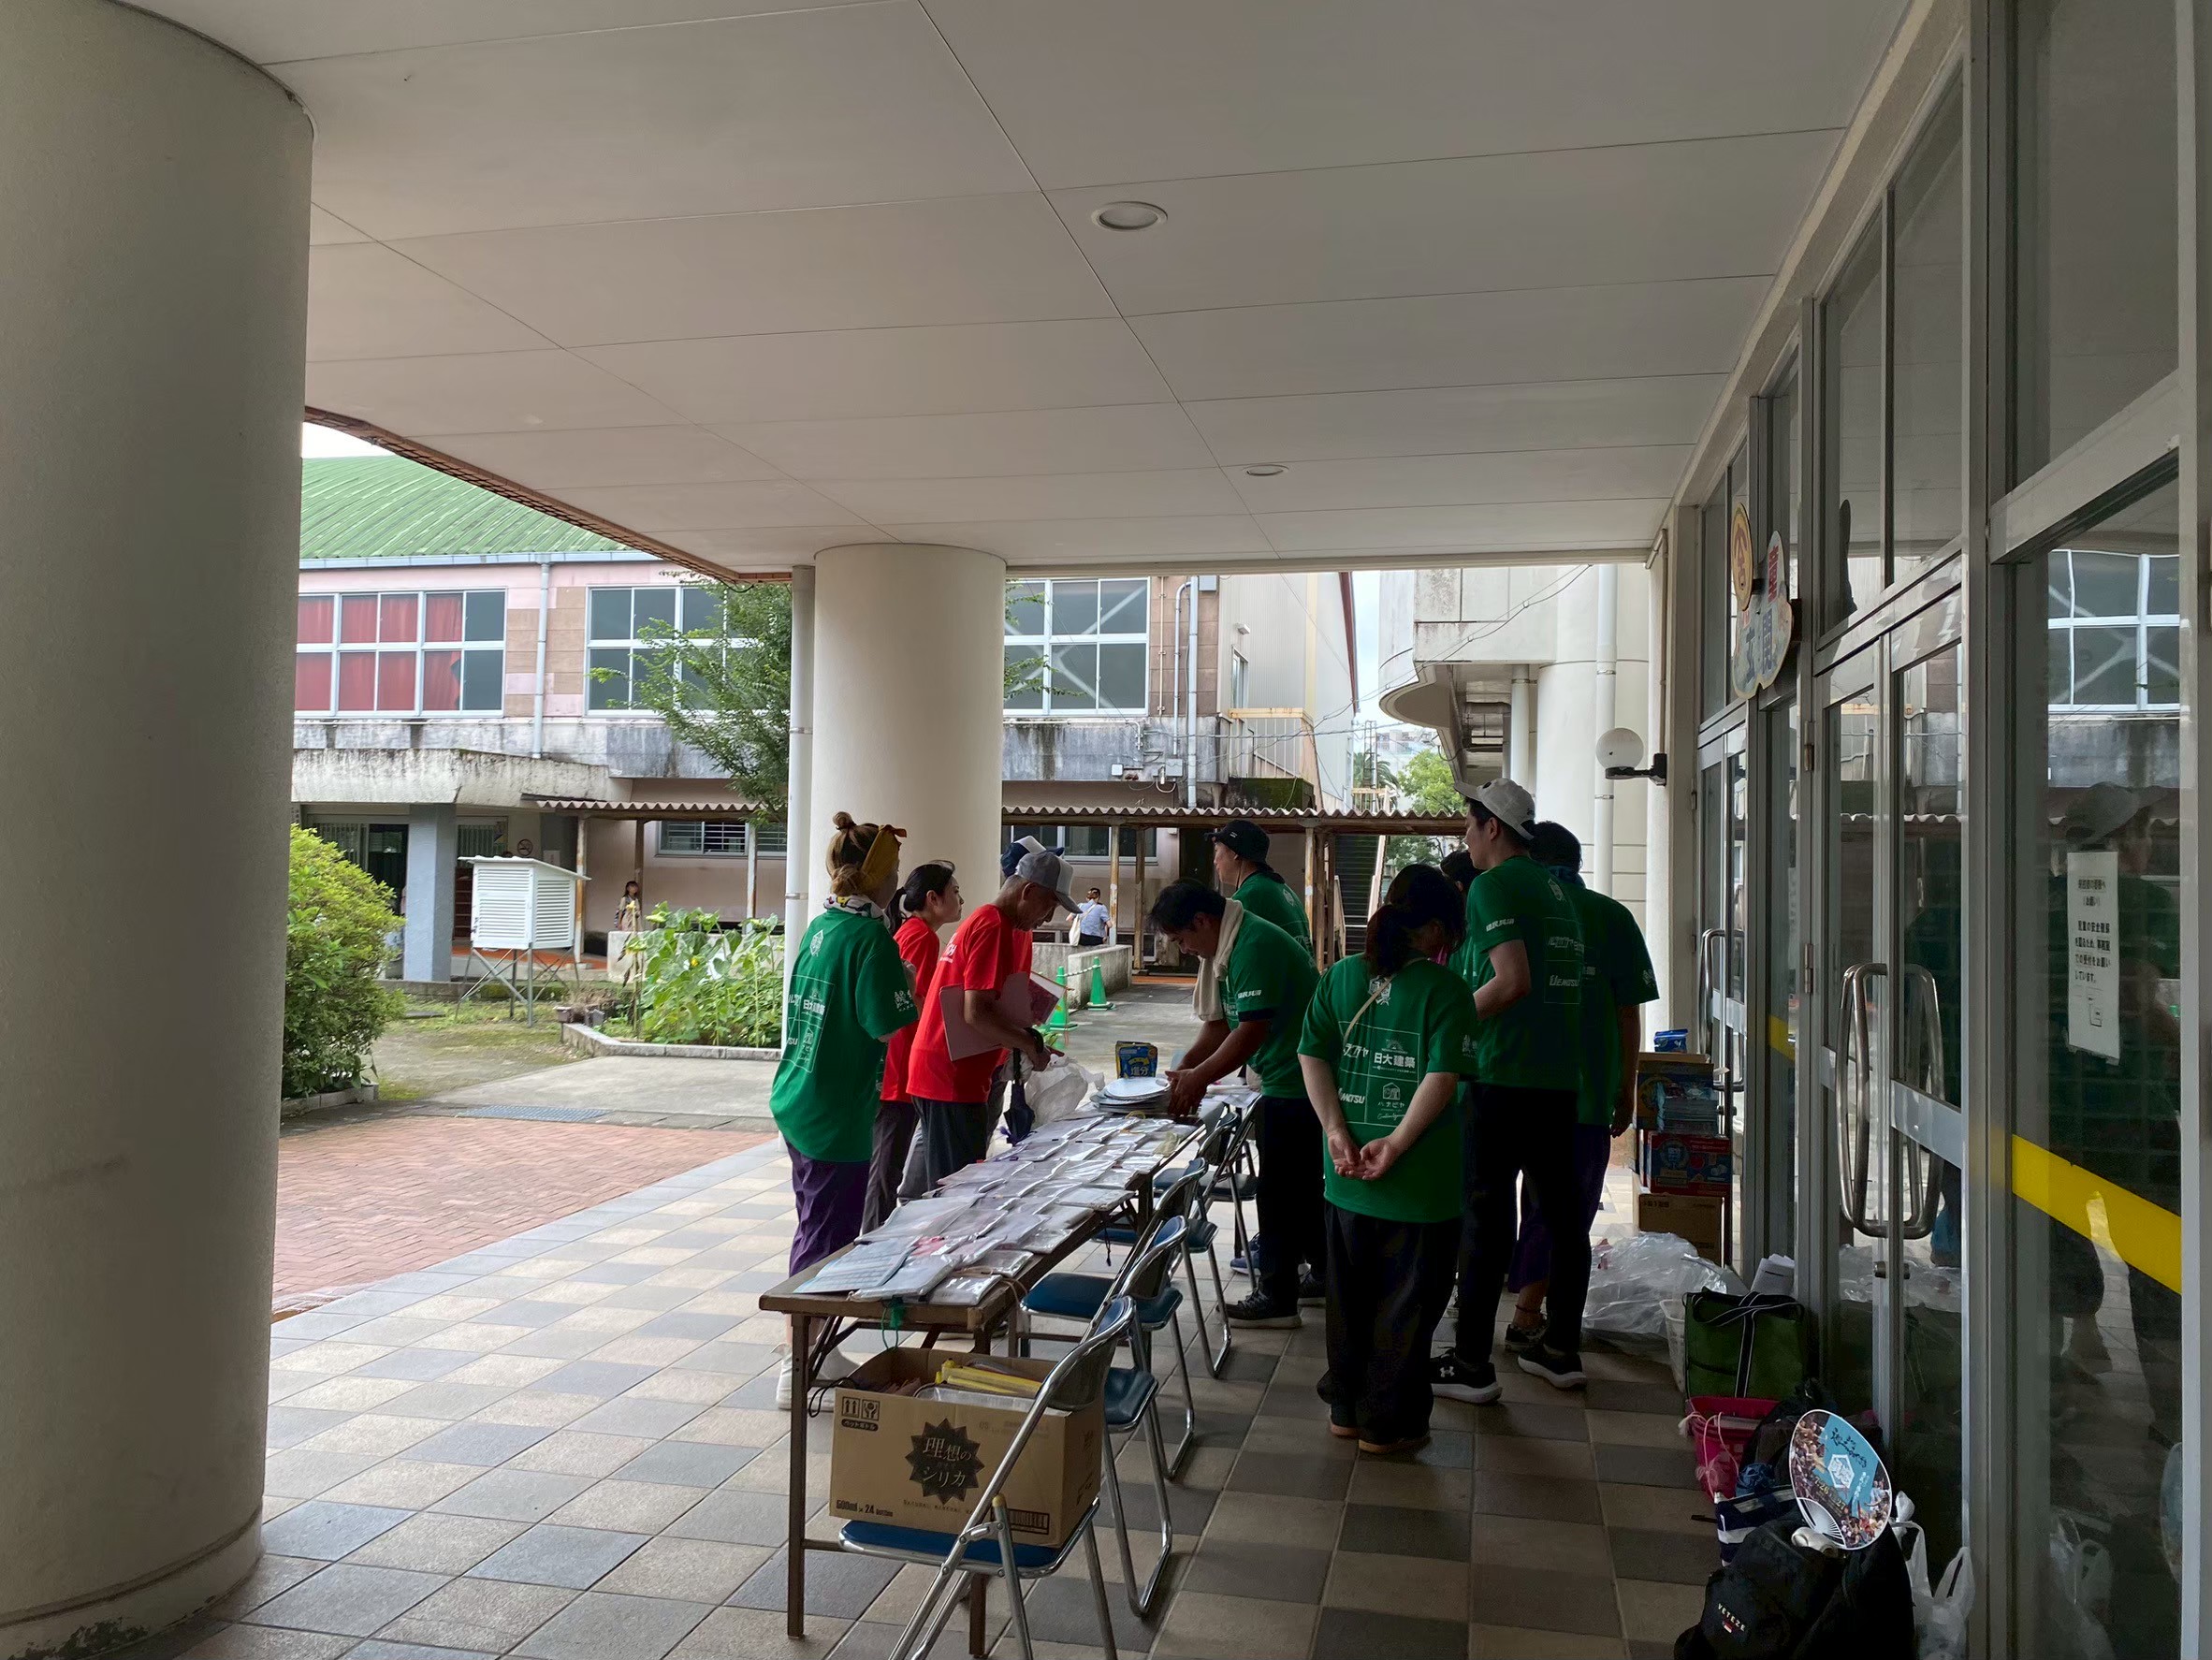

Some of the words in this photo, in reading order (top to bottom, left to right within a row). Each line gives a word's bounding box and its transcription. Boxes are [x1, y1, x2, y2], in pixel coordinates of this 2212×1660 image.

[1374, 1052, 1416, 1069] 日大建築
[923, 1437, 972, 1462] 理想の
[923, 1466, 967, 1488] シリカ
[865, 1504, 875, 1514] 24
